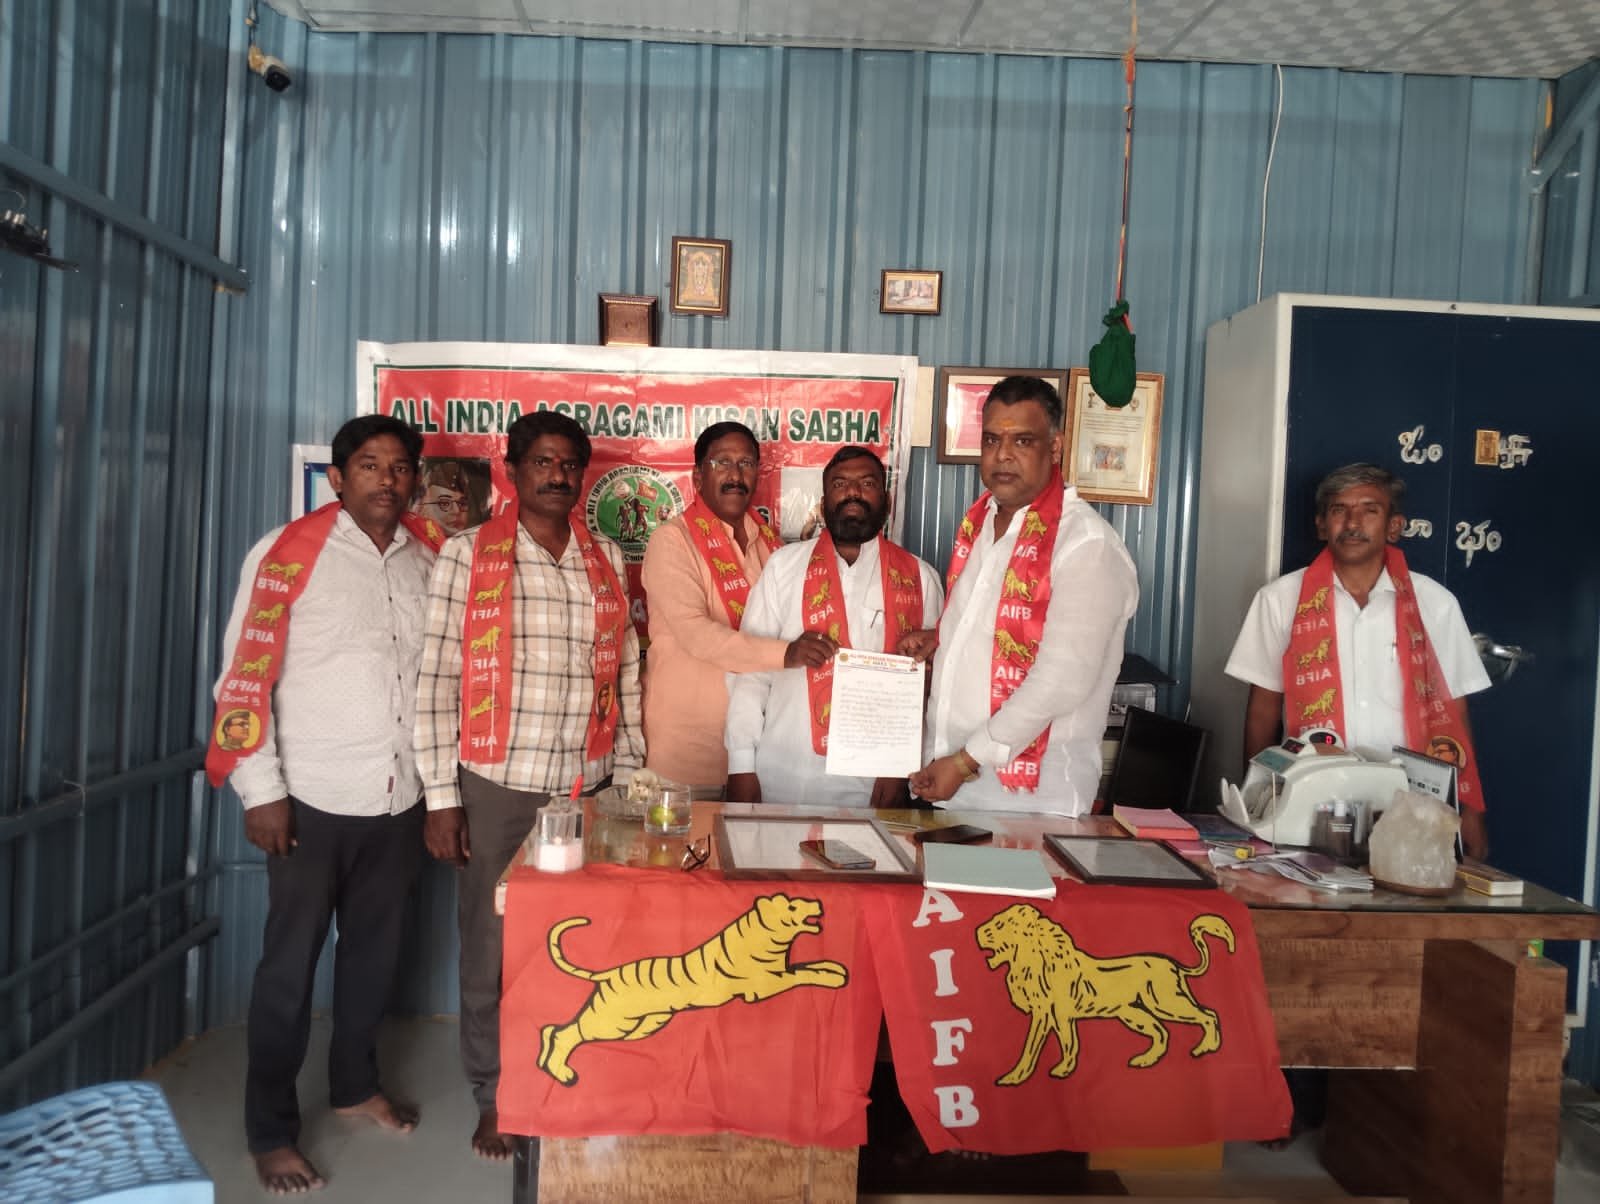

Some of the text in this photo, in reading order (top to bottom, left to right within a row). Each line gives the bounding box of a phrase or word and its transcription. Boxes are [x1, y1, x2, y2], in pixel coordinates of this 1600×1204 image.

[391, 399, 439, 433] ALL
[447, 399, 522, 435] INDIA
[537, 401, 684, 440] RAGAMI
[789, 408, 880, 443] SABHA
[723, 578, 748, 593] AIFB
[1000, 606, 1033, 621] AIFB
[994, 665, 1027, 681] AIF
[912, 888, 980, 1128] AIFB
